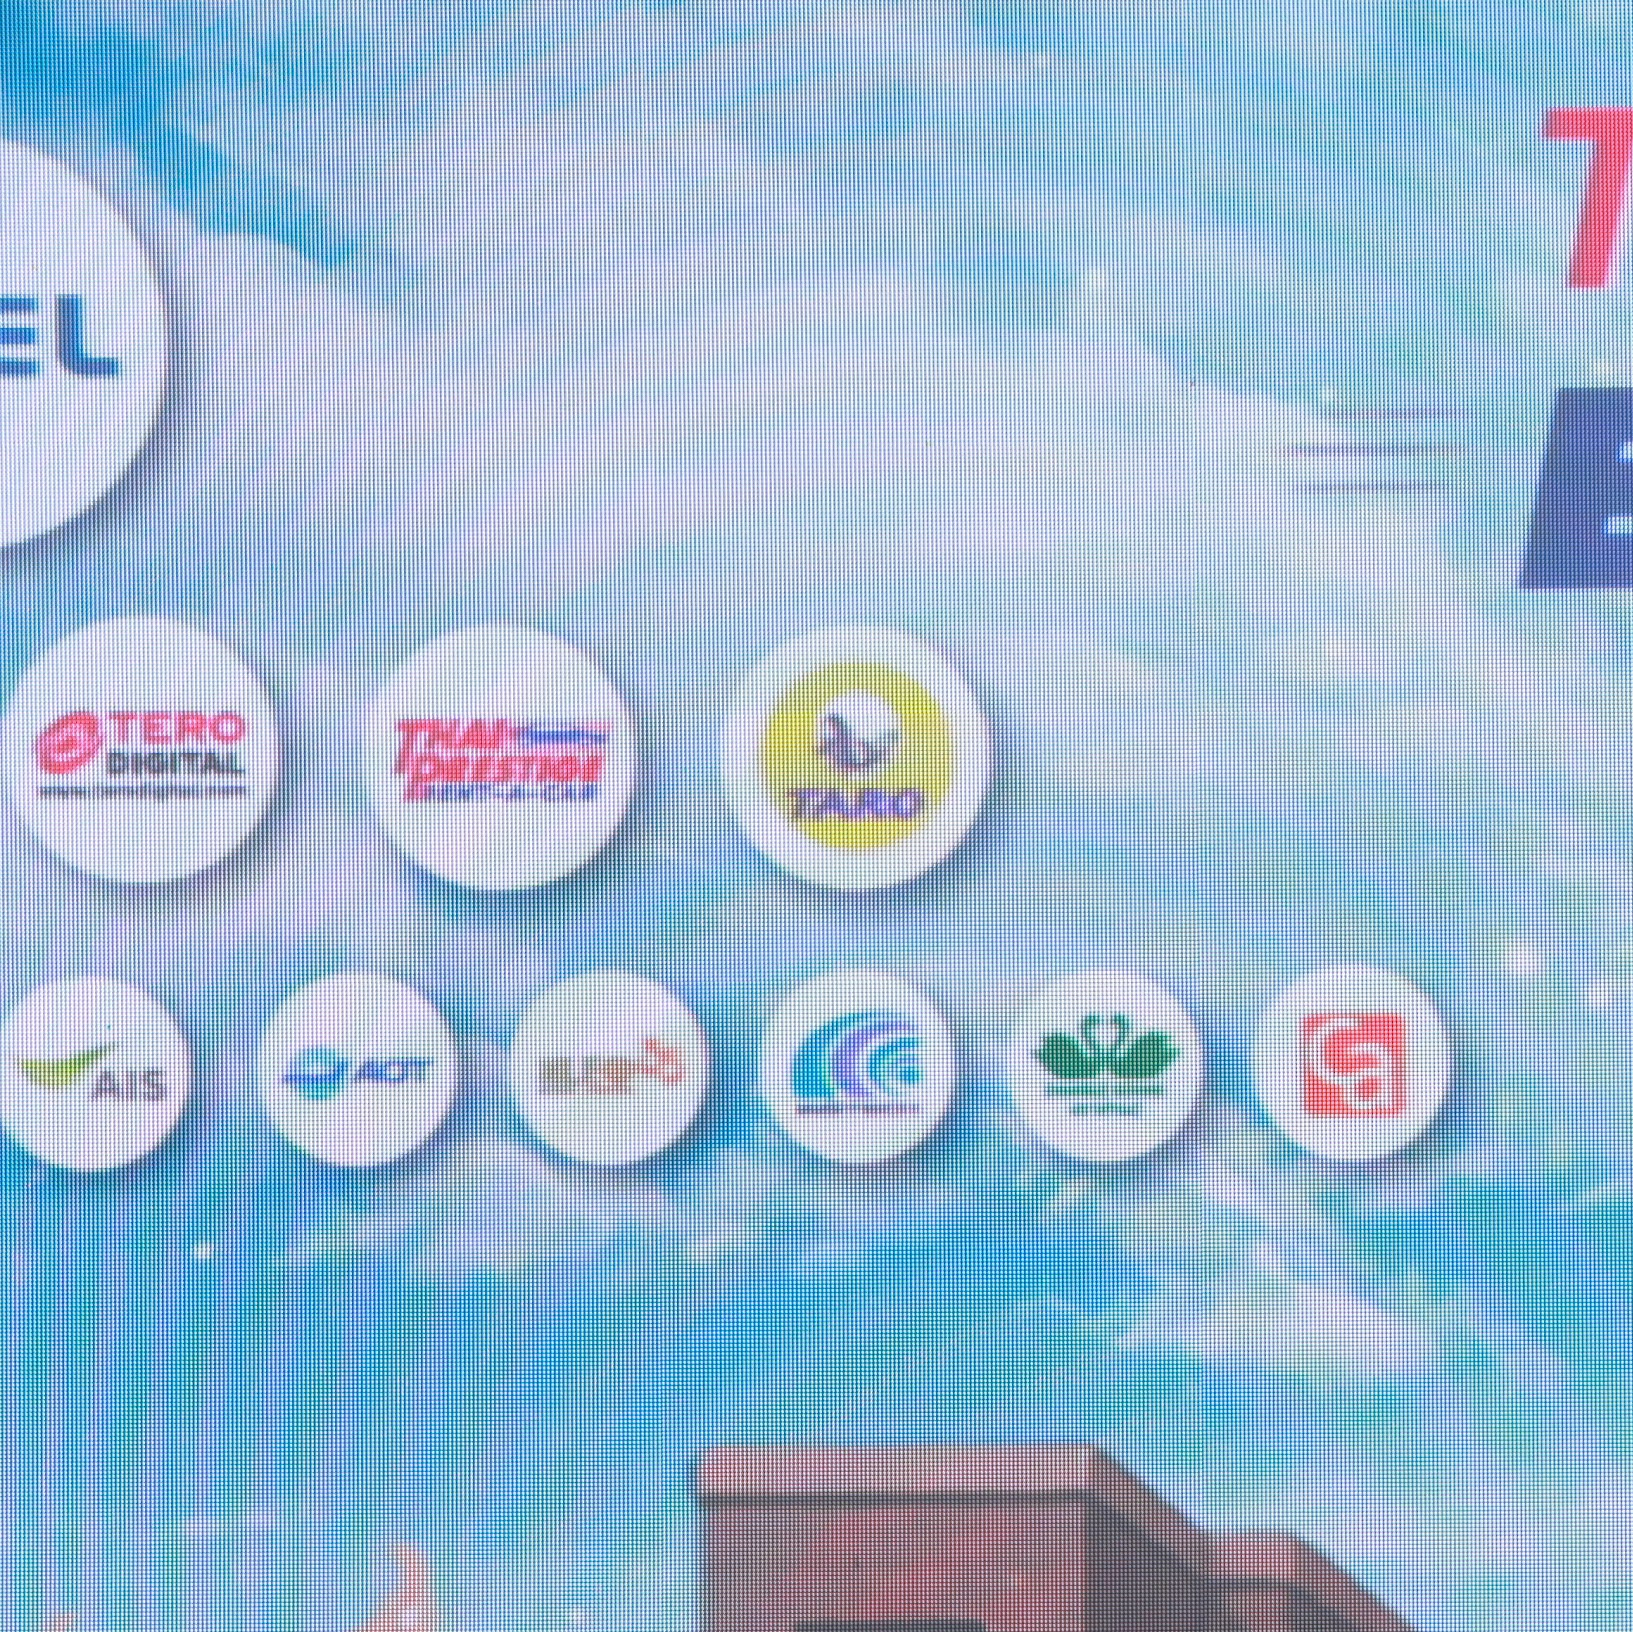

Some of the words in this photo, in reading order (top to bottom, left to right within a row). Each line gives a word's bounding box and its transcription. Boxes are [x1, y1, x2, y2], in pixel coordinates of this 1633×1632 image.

[107, 710, 248, 745] TERO
[394, 718, 506, 760] THAI
[105, 750, 247, 777] DIGITAL
[409, 753, 607, 788] PRESTIGE
[787, 786, 926, 819] TARO
[91, 1069, 169, 1101] AIS
[354, 1056, 433, 1084] AOT
